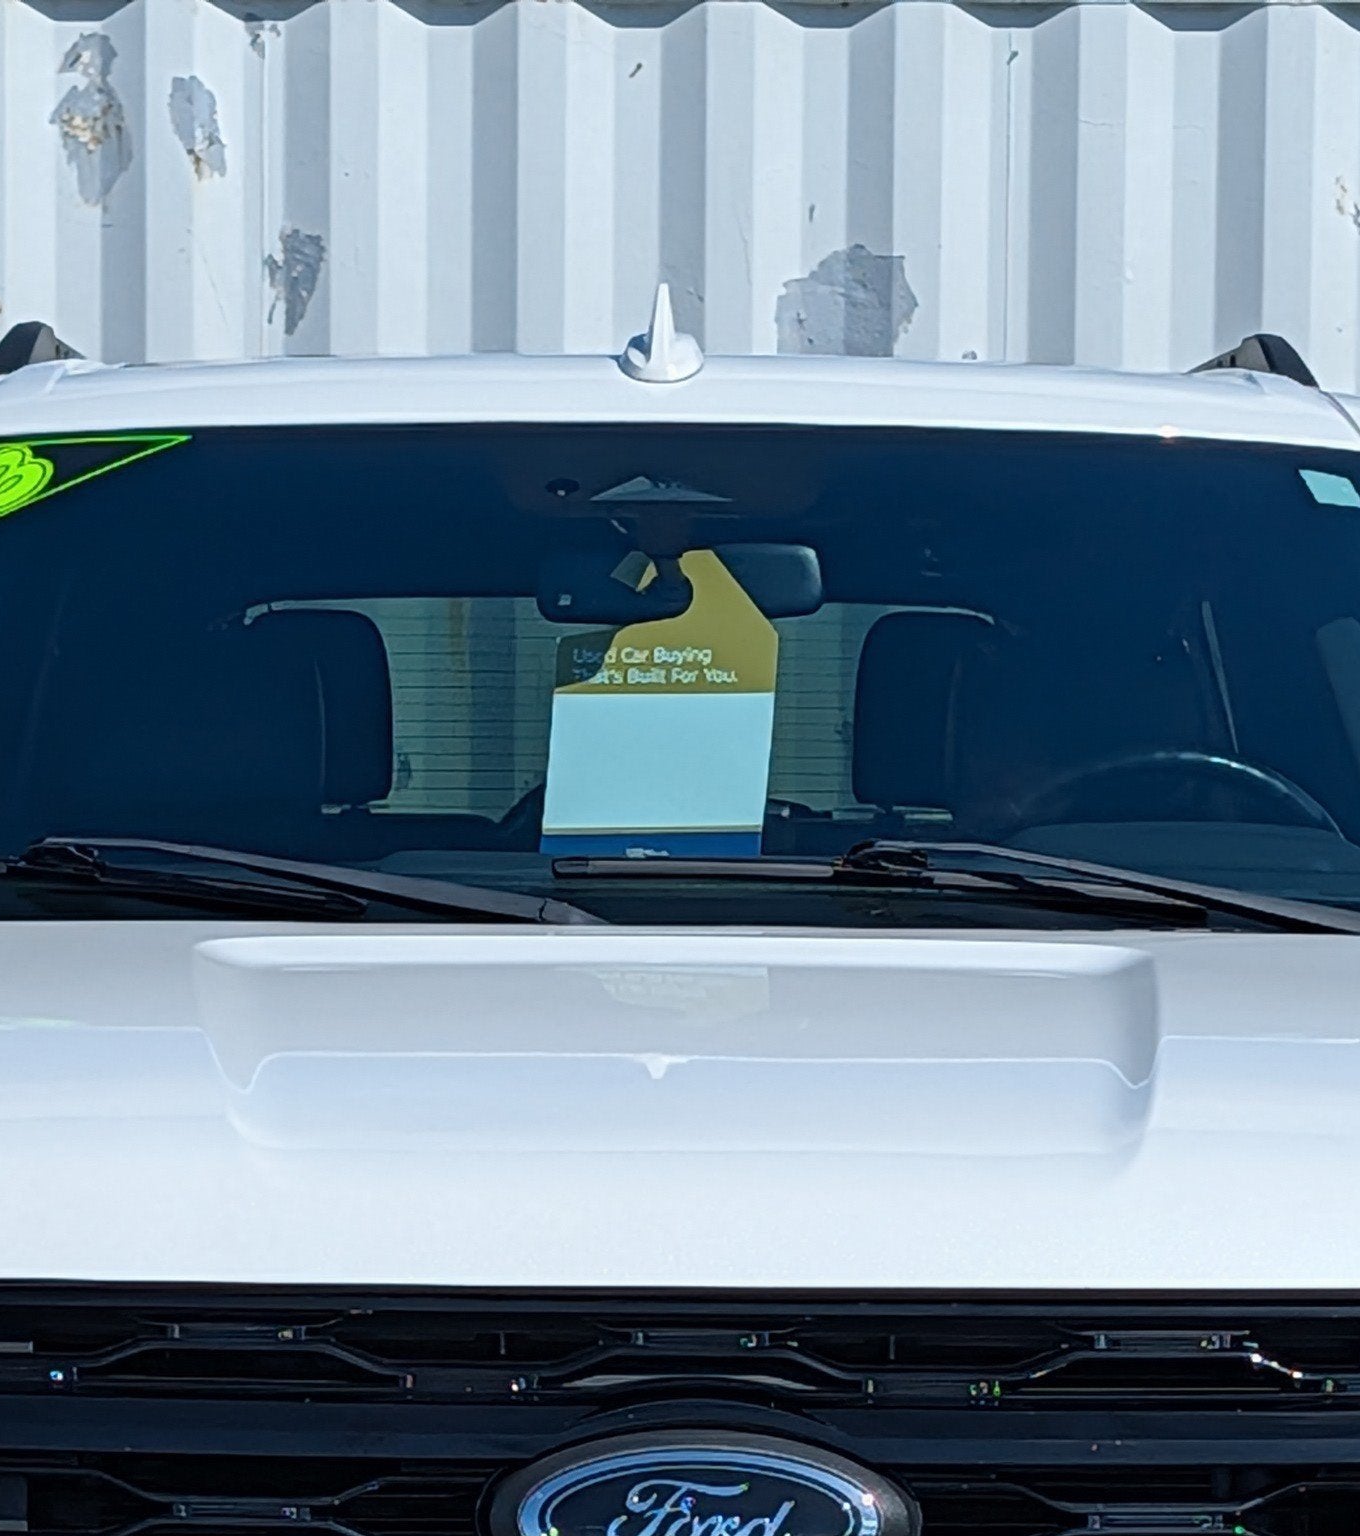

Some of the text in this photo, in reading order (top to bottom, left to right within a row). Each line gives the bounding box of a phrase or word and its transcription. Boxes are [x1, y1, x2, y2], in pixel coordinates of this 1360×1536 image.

[621, 647, 649, 664] Car
[653, 646, 713, 666] Buying
[627, 667, 667, 684] Built
[671, 667, 699, 684] For
